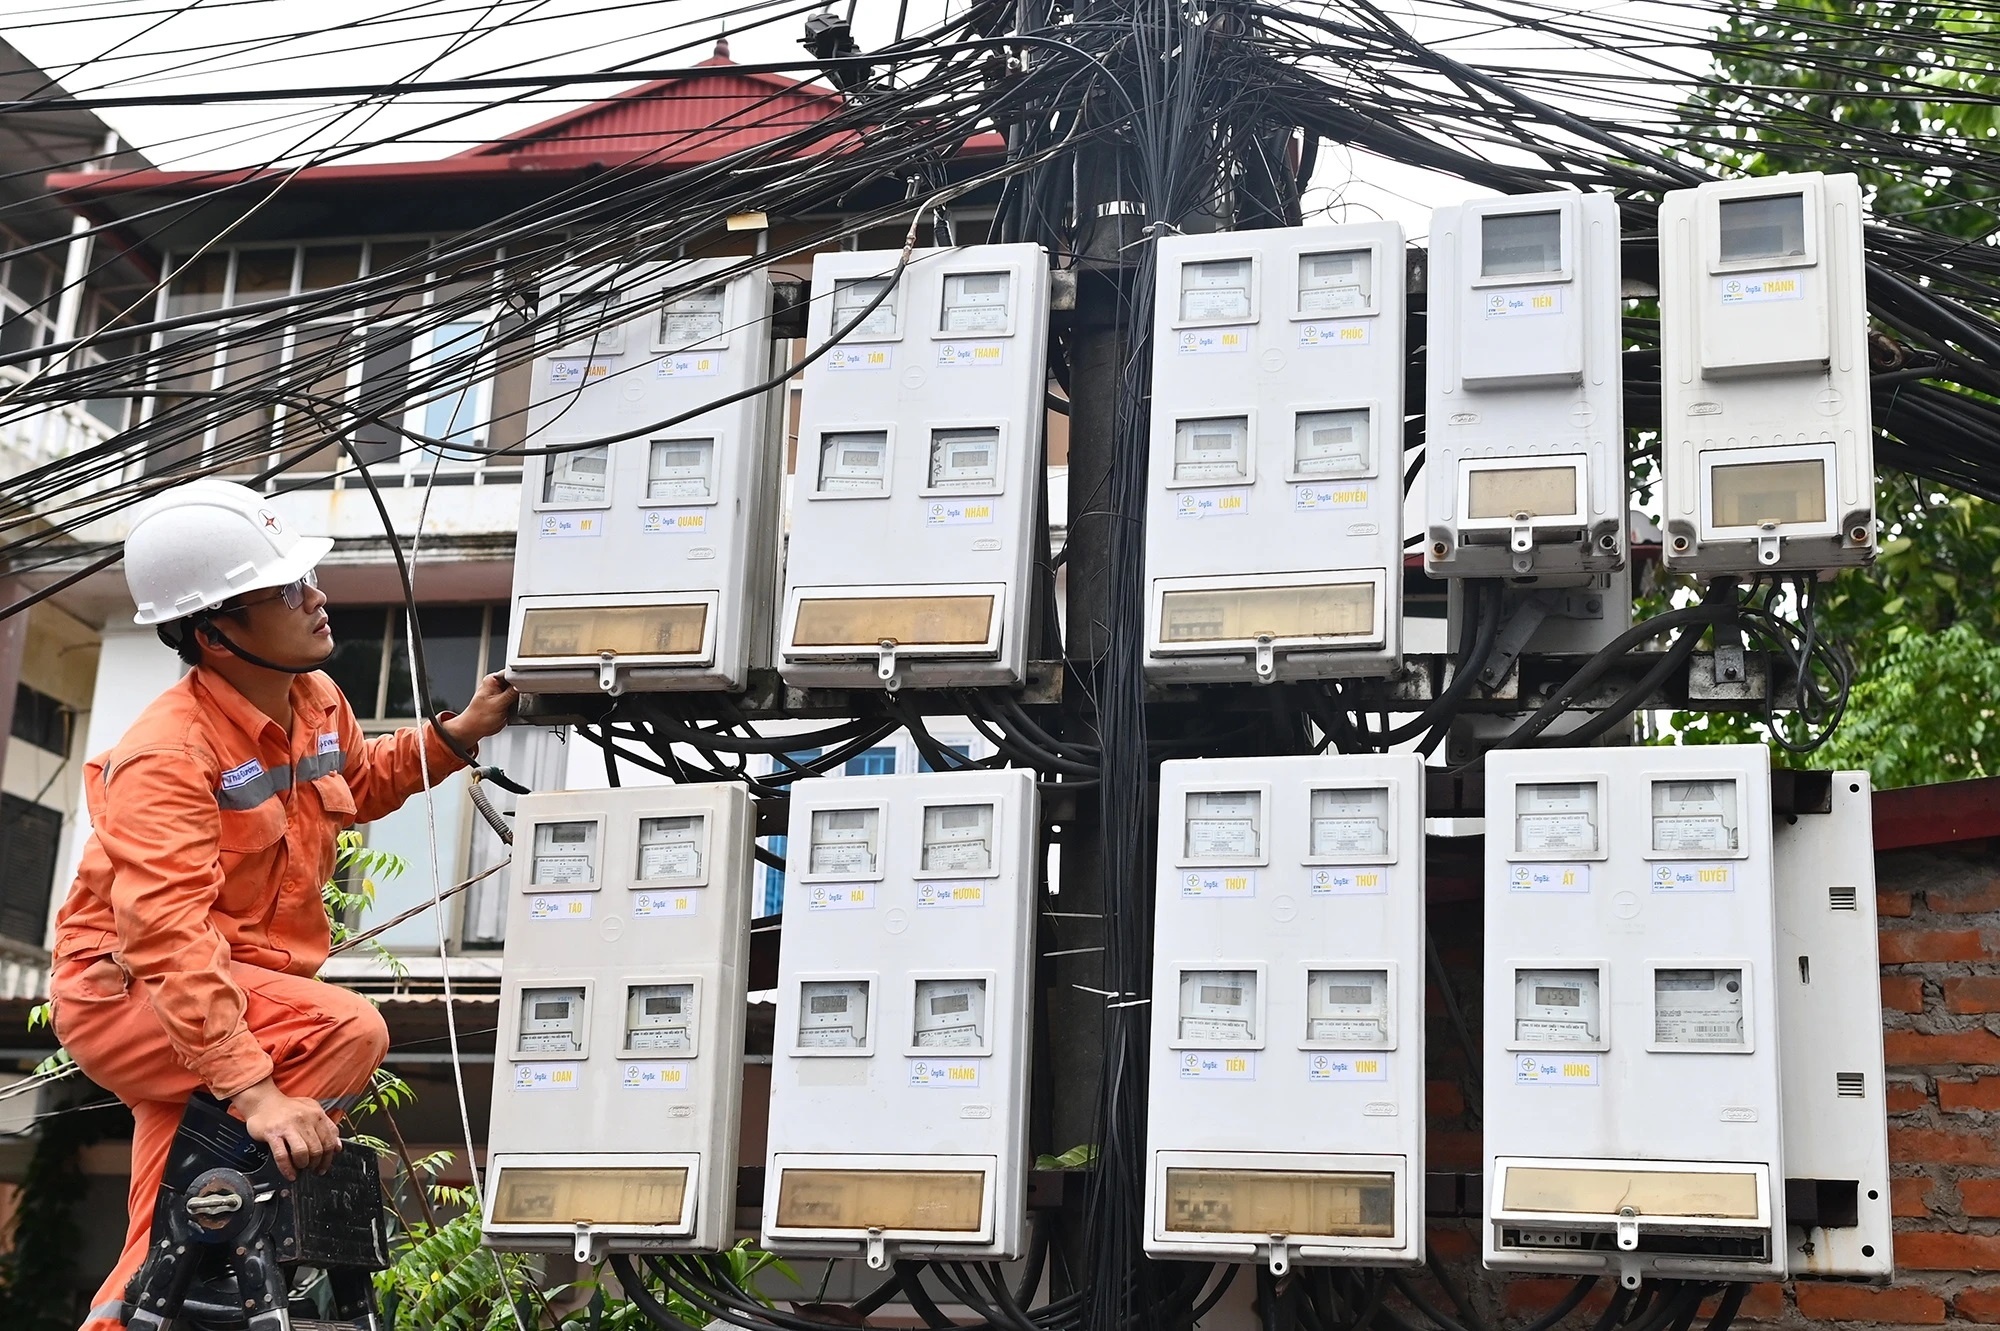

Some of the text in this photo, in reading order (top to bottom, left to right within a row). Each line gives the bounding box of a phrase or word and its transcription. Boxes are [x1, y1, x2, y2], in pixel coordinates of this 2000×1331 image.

[1222, 334, 1238, 344] MAI
[678, 516, 703, 526] QUANG
[1698, 866, 1727, 882] TUYẾT
[1356, 1061, 1376, 1072] VINH
[552, 1071, 572, 1082] LOAN
[661, 1066, 680, 1082] THẢO
